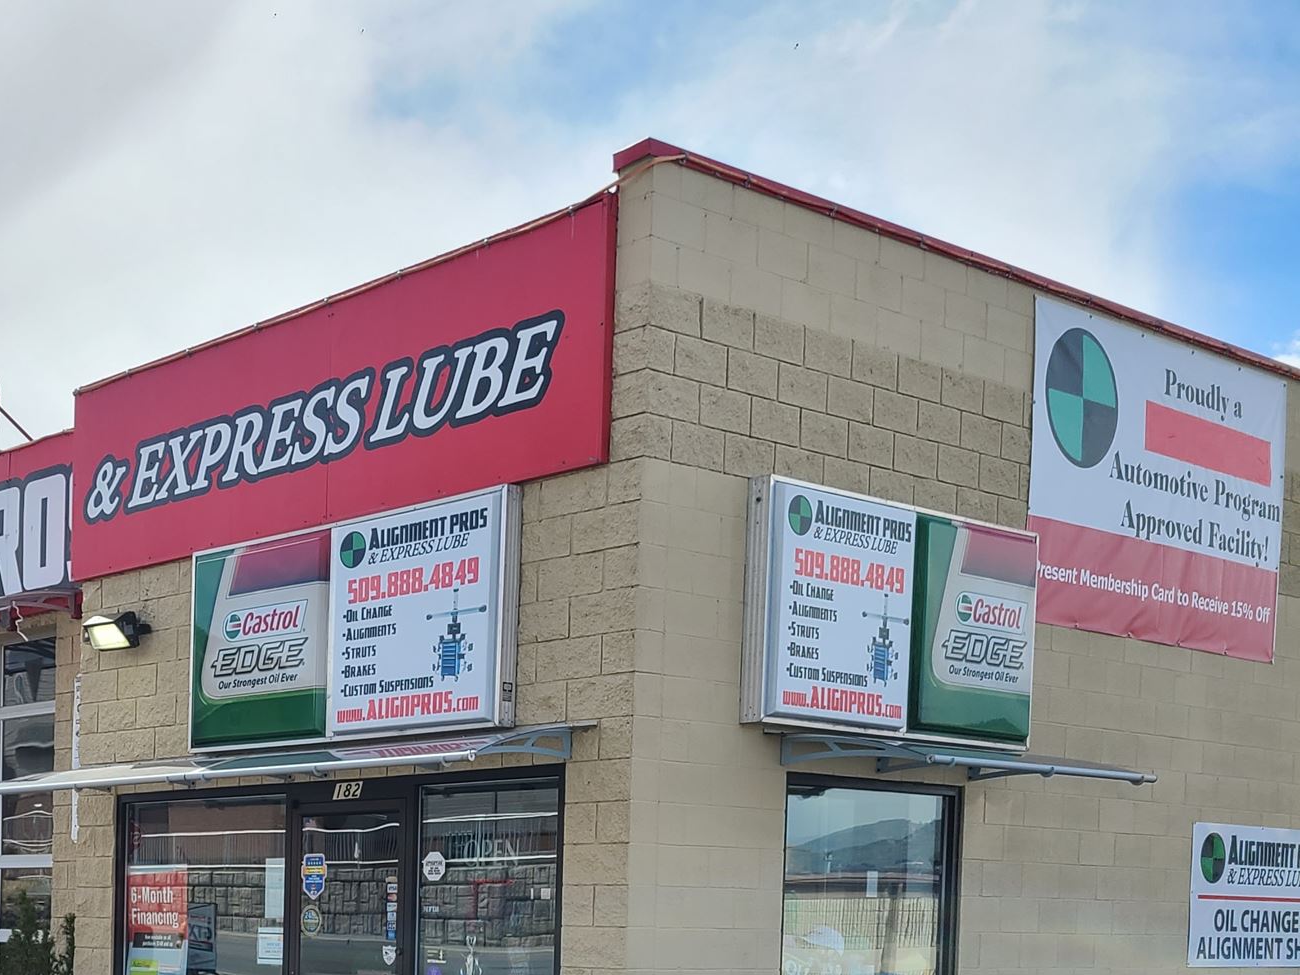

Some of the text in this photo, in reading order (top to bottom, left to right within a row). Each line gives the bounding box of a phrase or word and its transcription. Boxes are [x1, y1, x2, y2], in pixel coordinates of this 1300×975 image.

[1164, 368, 1242, 421] Proudly a
[87, 319, 559, 519] & EXPRESS LUBE
[1109, 450, 1280, 522] Automotive Program
[368, 507, 488, 550] ALIGNMENT PROS
[815, 500, 912, 543] ALIGNMENT PROS
[1120, 499, 1269, 568] Approved Facility!
[368, 532, 470, 565] & EXPRESS LUBE
[813, 526, 899, 555] & EXPRESS LUBE
[347, 556, 480, 604] 509.888.4849
[795, 547, 905, 594] 509.888.4849
[793, 580, 834, 601] OIL CHANGE
[1079, 569, 1149, 601] Membership
[1151, 583, 1175, 604] Card
[1177, 589, 1189, 606] to
[1191, 591, 1229, 615] Receive
[1231, 601, 1253, 620] 15%
[1255, 606, 1271, 624] Off
[242, 605, 300, 635] Castrol
[346, 604, 393, 623] OIL CHANGE
[792, 600, 837, 622] ALIGNMENTS
[973, 598, 1022, 629] Castrol
[345, 623, 397, 642] ALIGNMENTS
[791, 621, 820, 640] STRUTS
[211, 637, 309, 678] EDGE
[345, 645, 376, 660] STRUTS
[789, 642, 819, 660] BRAKES
[941, 629, 1028, 671] EDGE
[218, 673, 298, 690] Our Strongest Oil Ever
[344, 664, 376, 679] BRAKES
[789, 663, 868, 688] CUSTOM SUSPENSIONS
[948, 664, 1019, 683] Our Strongest Oil Ever
[343, 675, 434, 698] CUSTOM SUSPENSIONS
[337, 691, 479, 724] www.ALIGNPROS.com
[782, 685, 902, 719] www.ALIGNPROS.com
[336, 782, 361, 798] 182
[464, 839, 520, 867] OPEN
[1228, 835, 1296, 868] ALIGNMENT
[1227, 868, 1238, 884] &
[1237, 868, 1285, 887] EXPRESS
[130, 886, 174, 904] 6-Month
[131, 908, 180, 929] Financing
[1214, 909, 1300, 933] OIL CHANGE
[1196, 936, 1283, 960] ALIGNMENT
